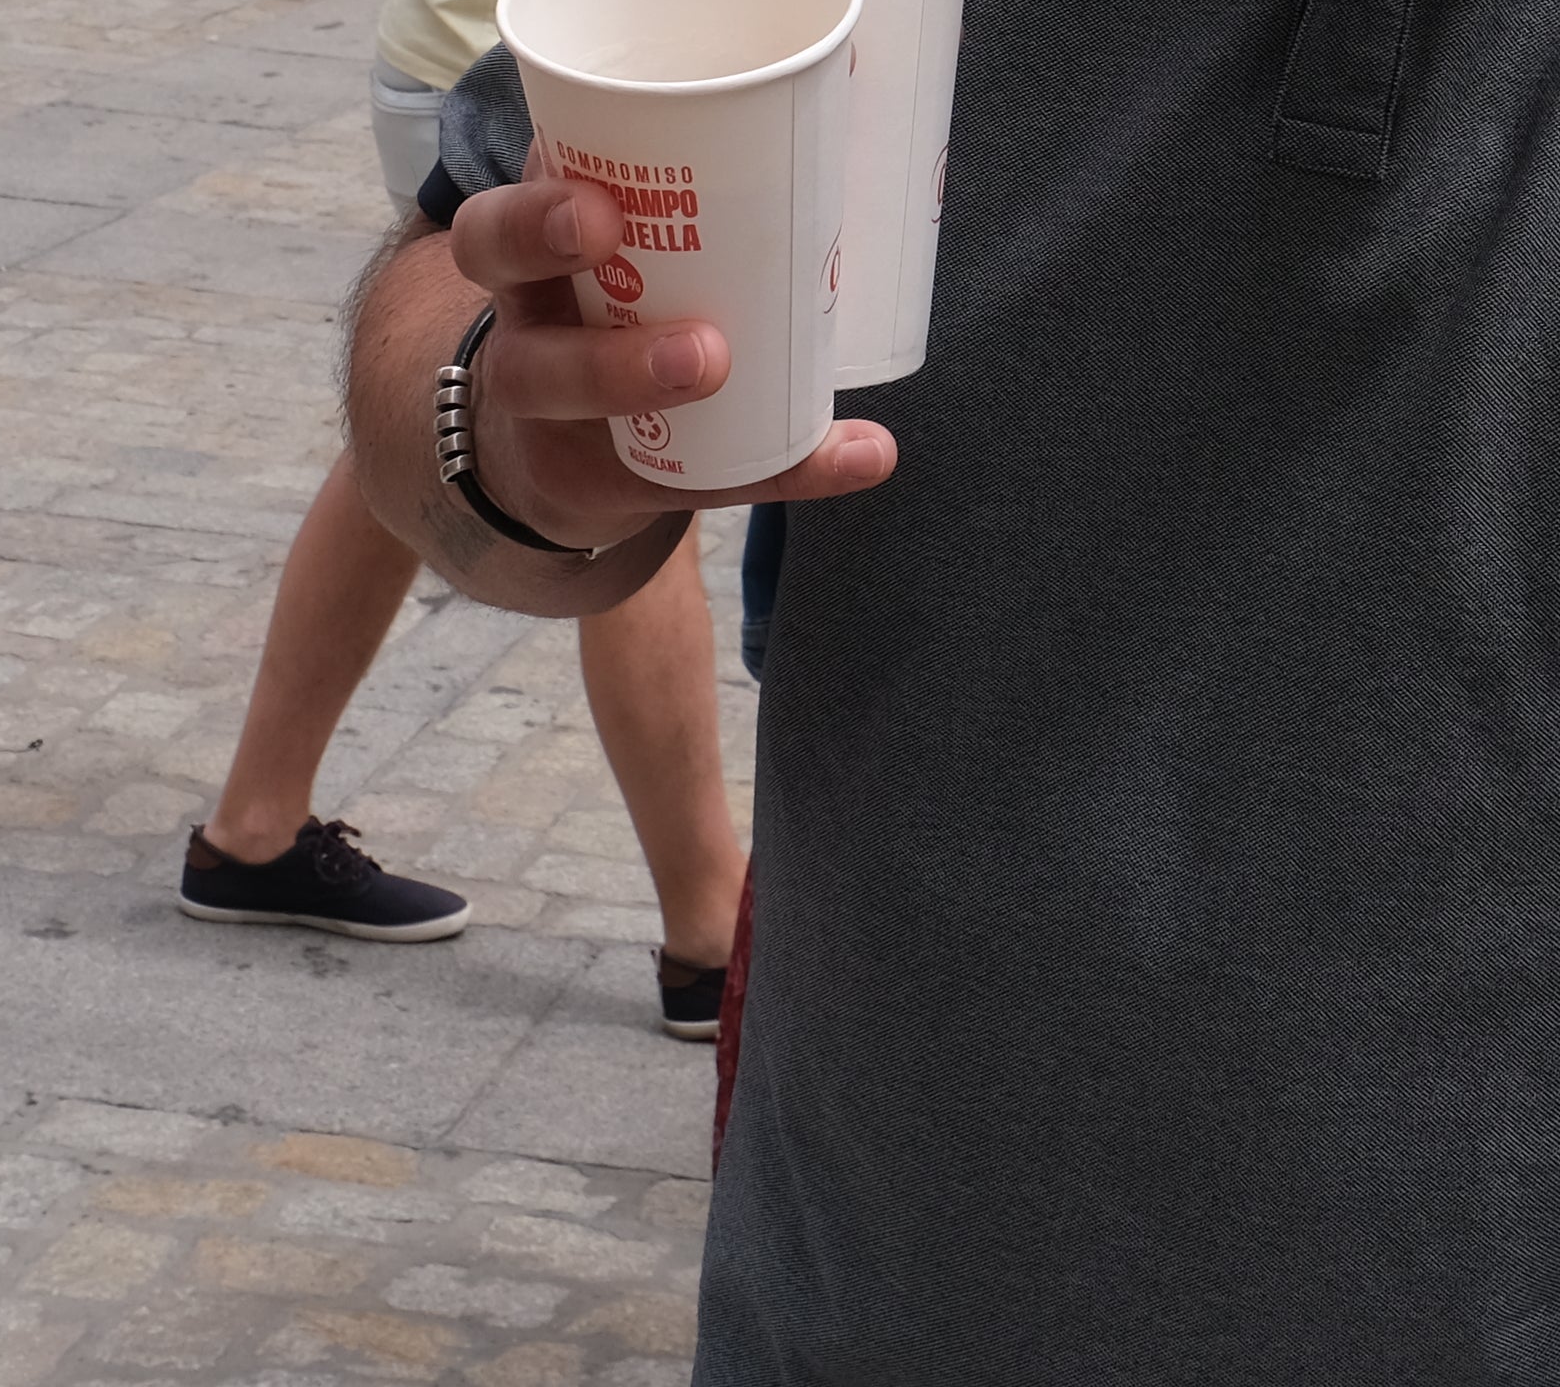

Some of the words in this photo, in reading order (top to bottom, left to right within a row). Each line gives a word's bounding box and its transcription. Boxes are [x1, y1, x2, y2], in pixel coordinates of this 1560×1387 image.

[557, 140, 693, 184] COMPROMISO
[599, 264, 642, 294] 100%
[606, 302, 642, 326] PAPEL
